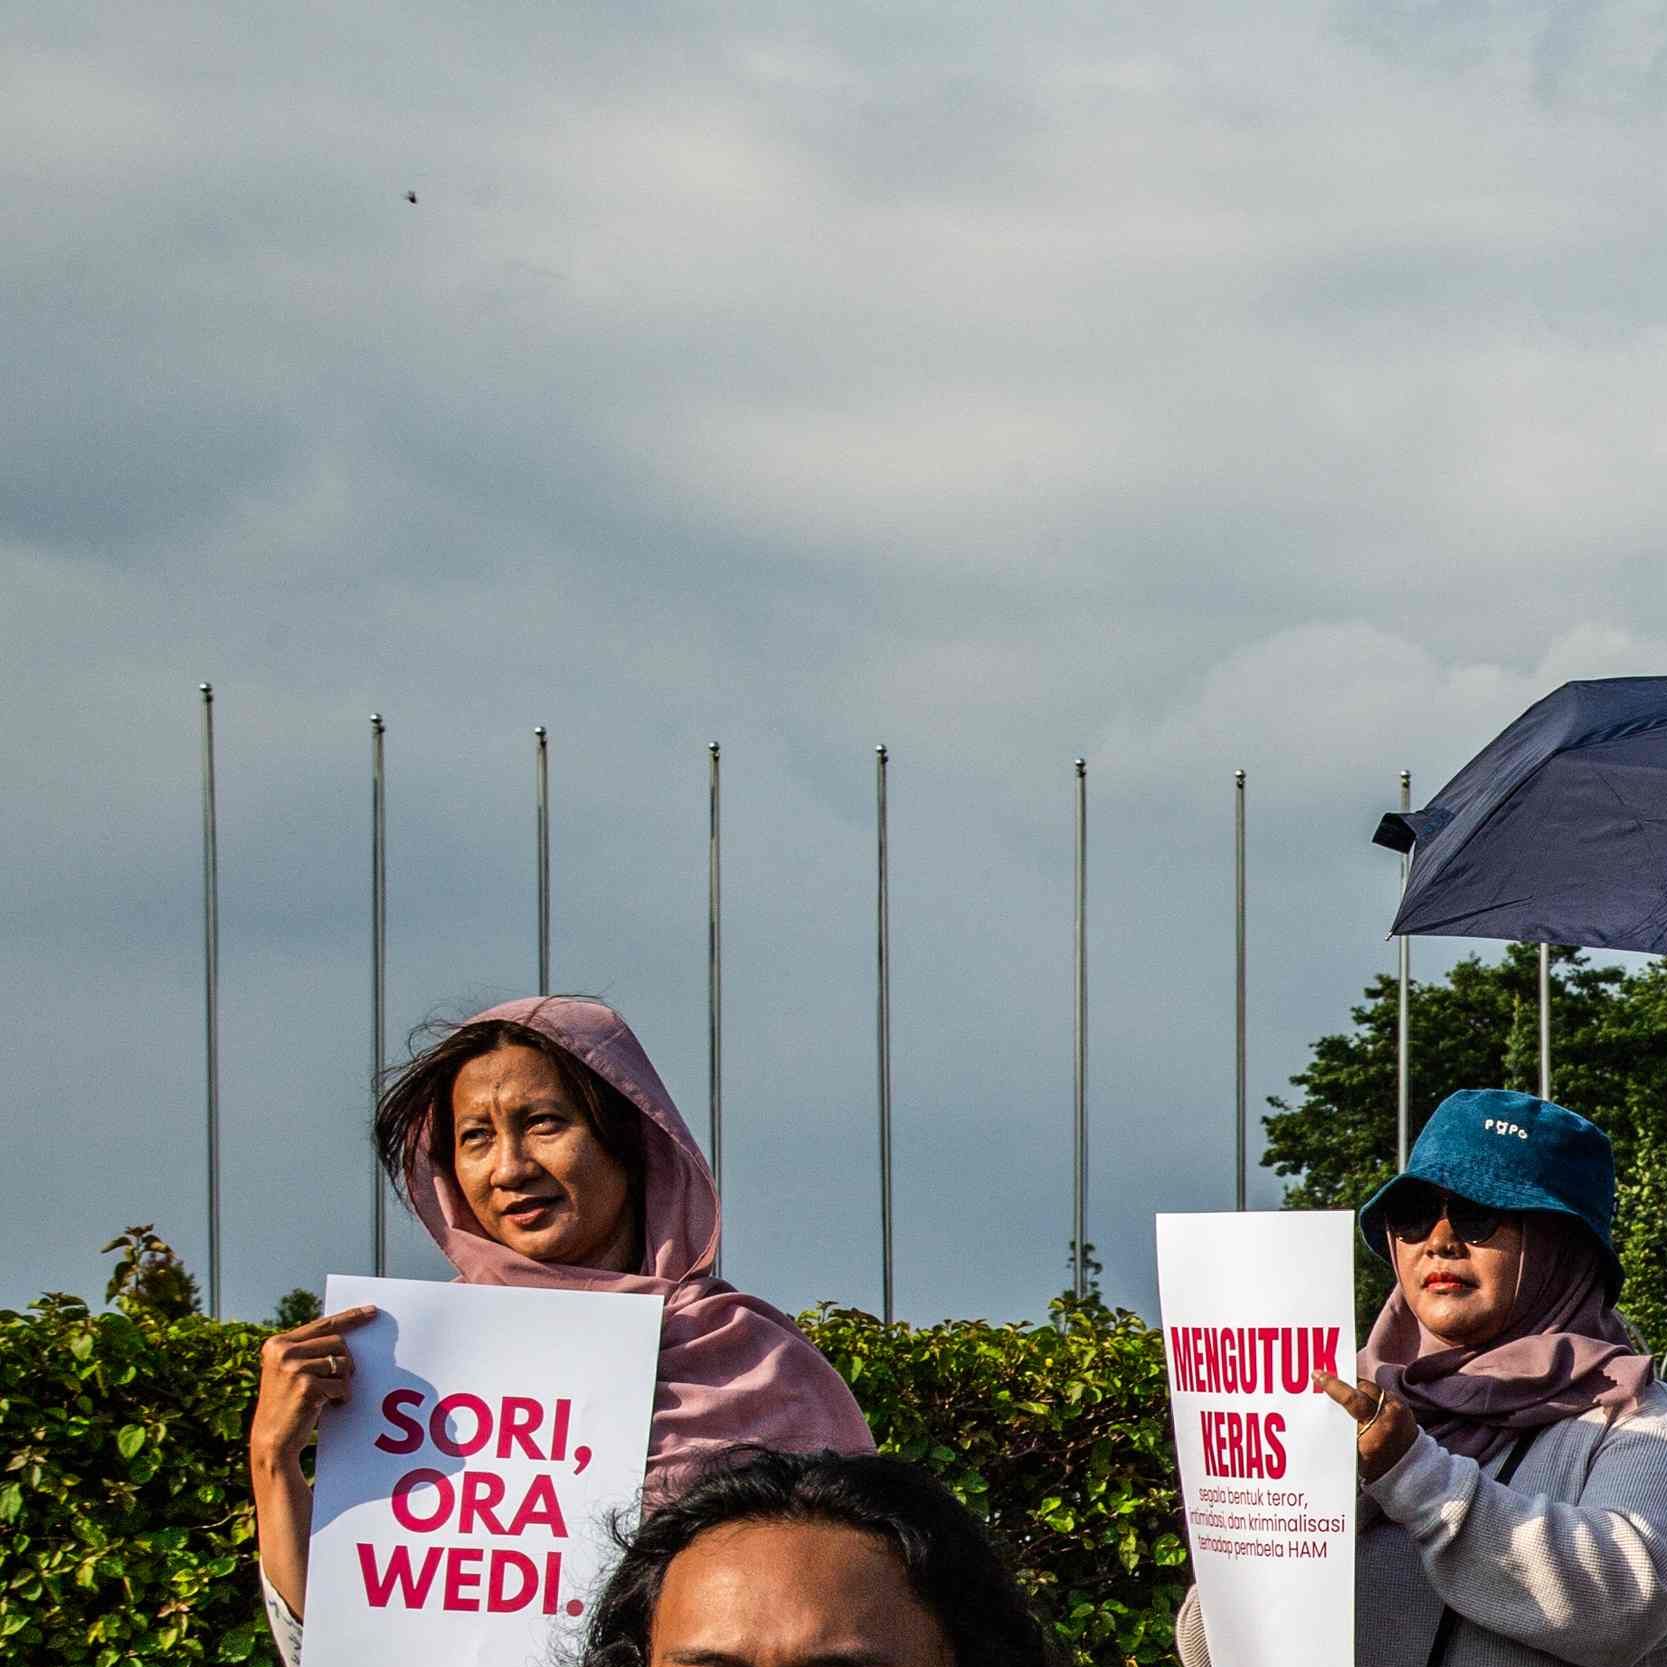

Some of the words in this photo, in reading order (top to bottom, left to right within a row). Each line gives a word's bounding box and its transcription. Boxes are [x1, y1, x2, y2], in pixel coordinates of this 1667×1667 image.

[1171, 1327, 1340, 1394] MENGUTUK
[375, 1389, 592, 1474] SORI,
[1201, 1411, 1286, 1479] KERAS
[391, 1468, 568, 1537] ORA
[1200, 1486, 1226, 1507] segala
[1228, 1488, 1264, 1506] bentuk
[1267, 1489, 1308, 1509] teror,
[1228, 1511, 1246, 1530] dan
[1250, 1514, 1345, 1532] kriminalisasi
[356, 1543, 583, 1616] WEDI.
[1235, 1540, 1283, 1560] pembela
[1289, 1541, 1327, 1558] HAM
